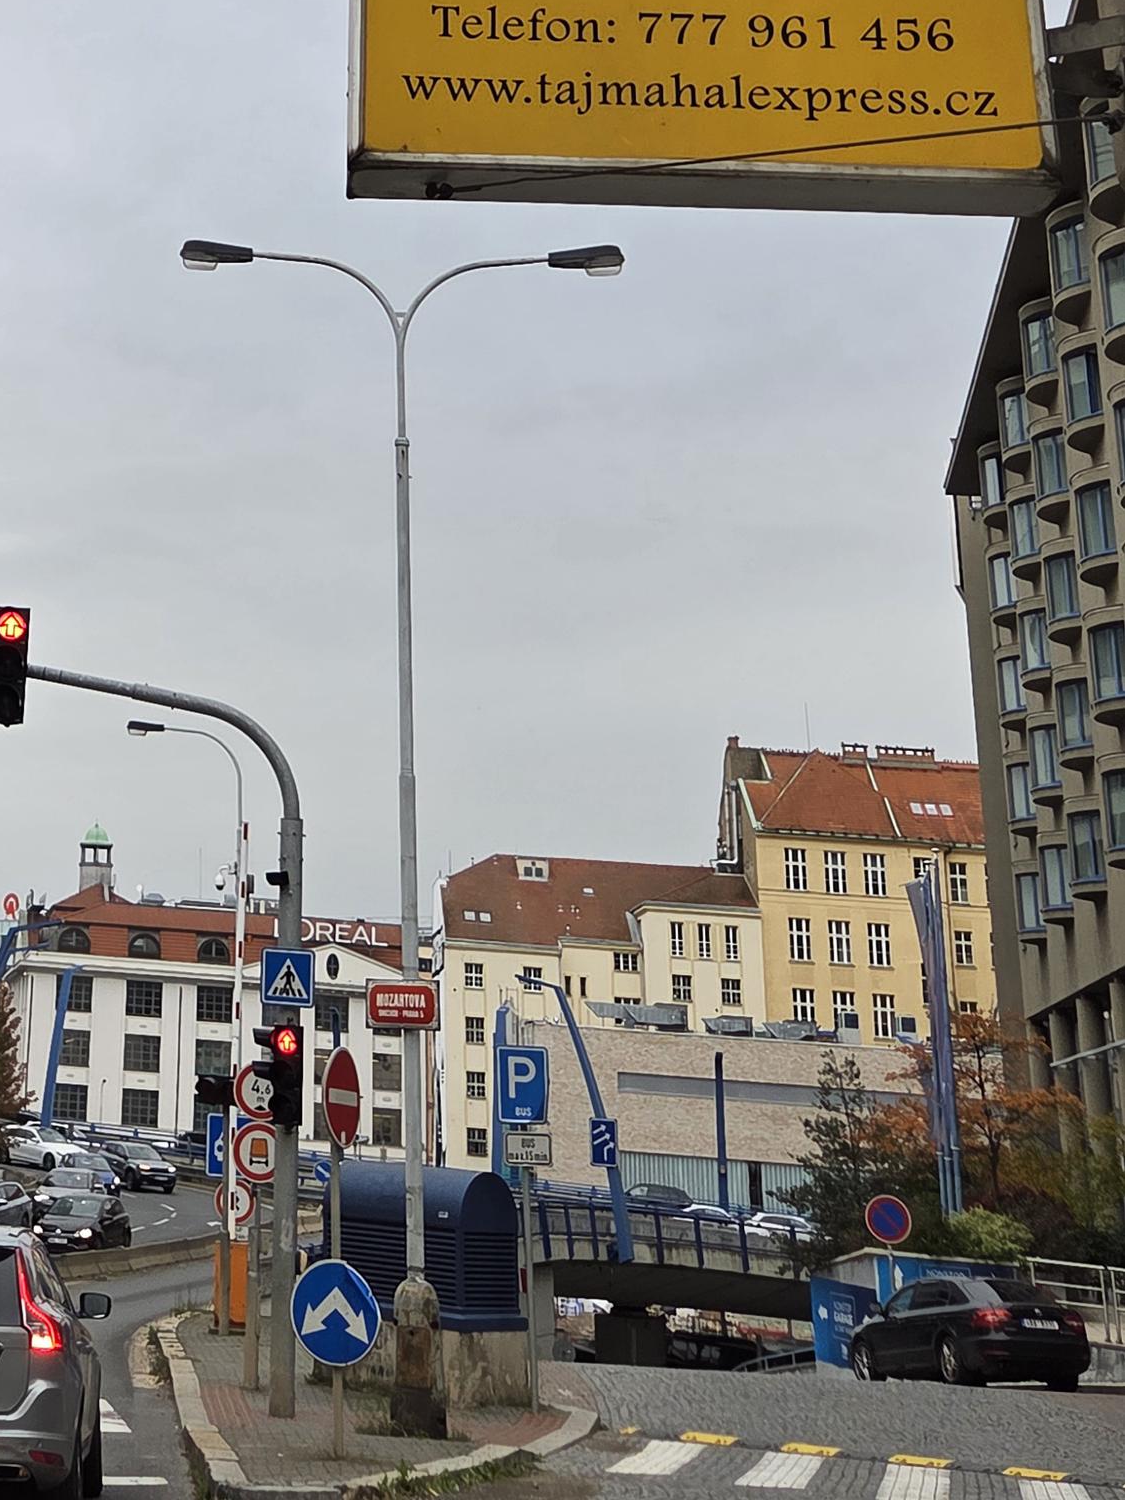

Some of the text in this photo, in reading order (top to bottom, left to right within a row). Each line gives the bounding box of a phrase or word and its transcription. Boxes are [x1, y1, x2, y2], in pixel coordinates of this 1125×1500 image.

[432, 5, 953, 51] Telefon: 777 961 456
[402, 72, 997, 121] www.tajmahalexpress.cz
[376, 993, 426, 1008] MOZARTOVA
[515, 1106, 532, 1117] BUS
[521, 1138, 535, 1149] BUS
